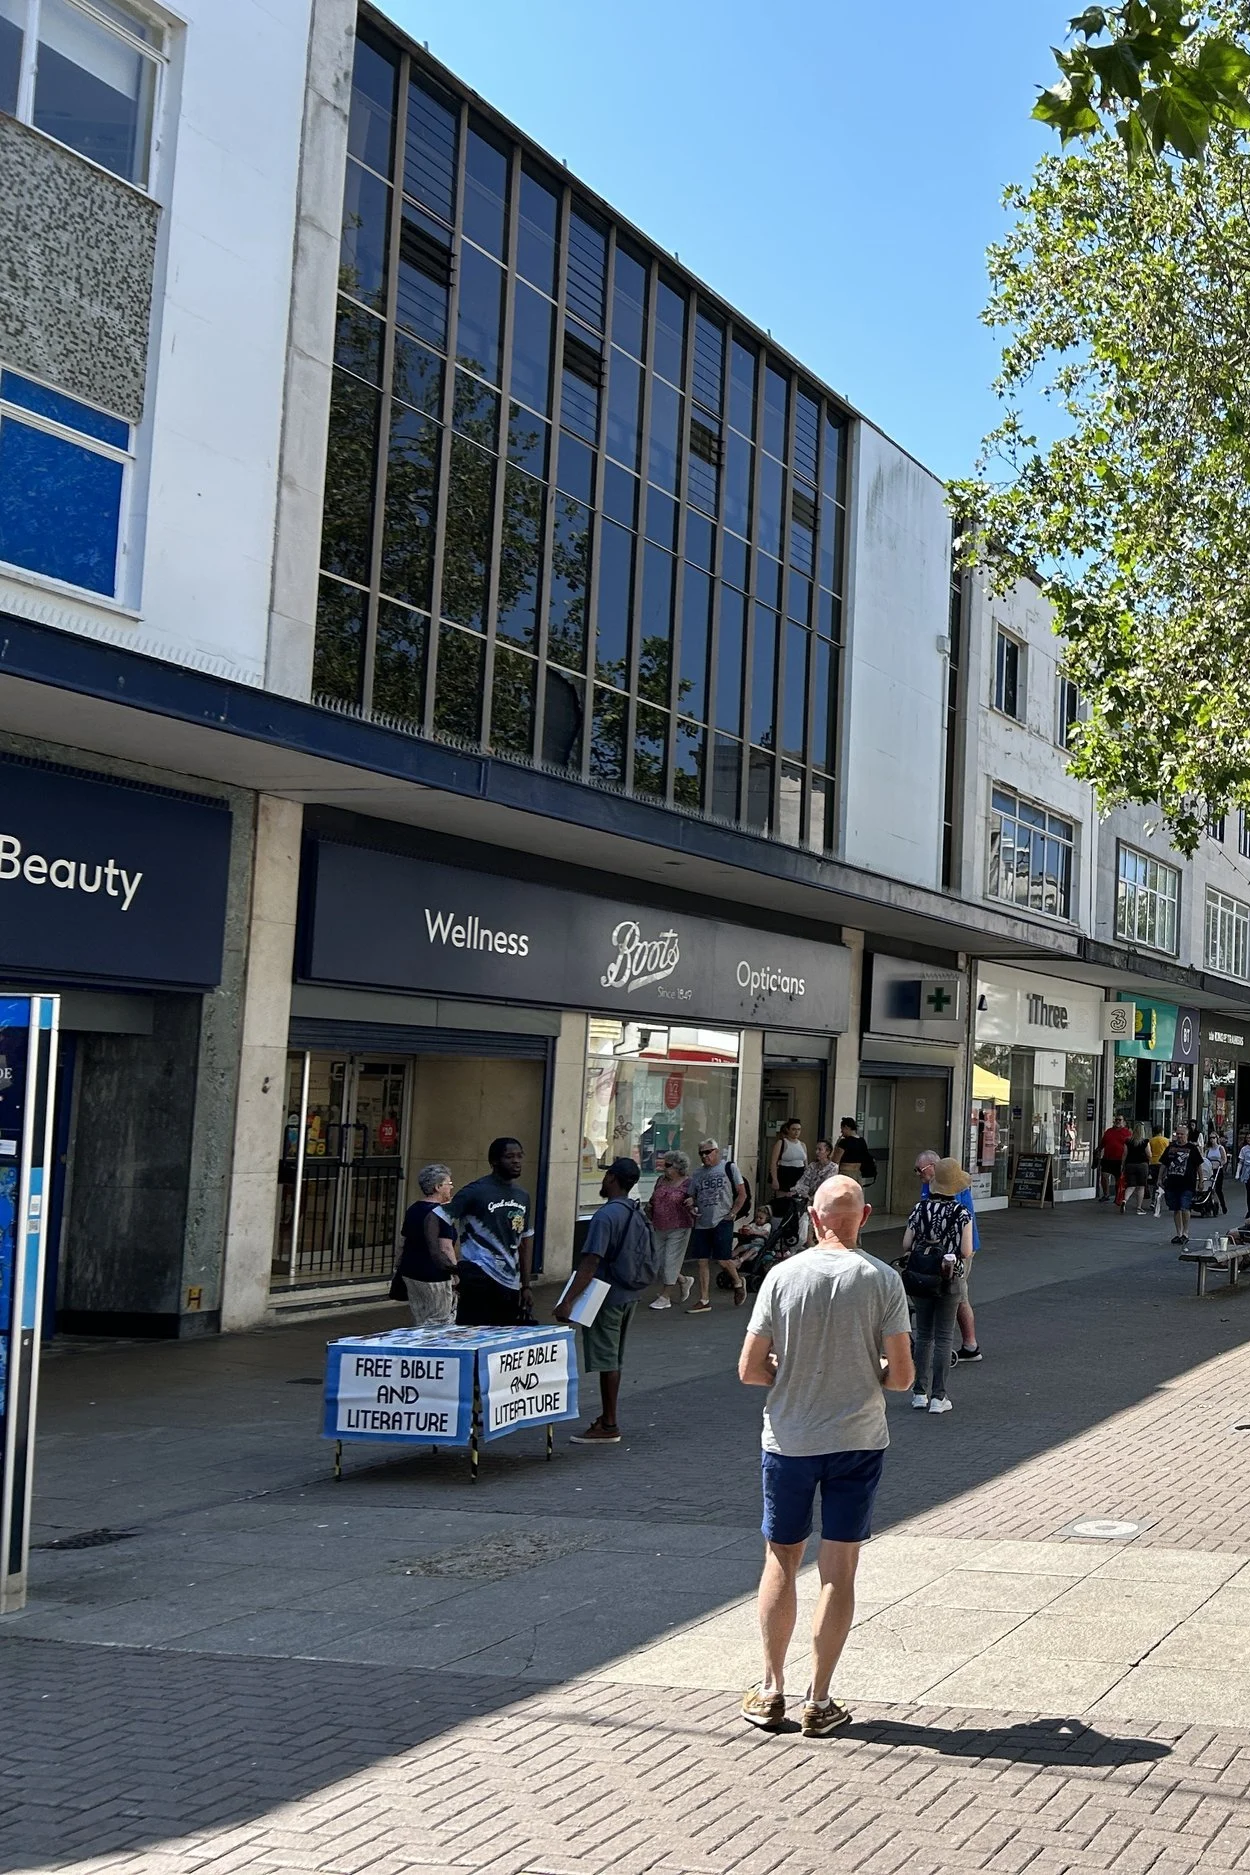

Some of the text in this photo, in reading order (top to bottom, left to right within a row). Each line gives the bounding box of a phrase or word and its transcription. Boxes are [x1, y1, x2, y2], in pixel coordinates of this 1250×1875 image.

[0, 834, 143, 911] Beauty
[424, 908, 529, 957] Wellness
[601, 921, 680, 993] Boots
[736, 960, 805, 996] Opticians
[657, 985, 693, 1000] Since 1849
[1027, 993, 1069, 1029] Three
[1183, 1028, 1190, 1043] BT
[187, 1288, 202, 1310] H
[355, 1357, 445, 1380] FREE BIBLE
[500, 1344, 558, 1374] FREE BIBLE
[377, 1385, 419, 1405] AND
[510, 1372, 540, 1394] AND
[347, 1409, 448, 1432] LITERATURE
[495, 1391, 561, 1426] LITERATURE
